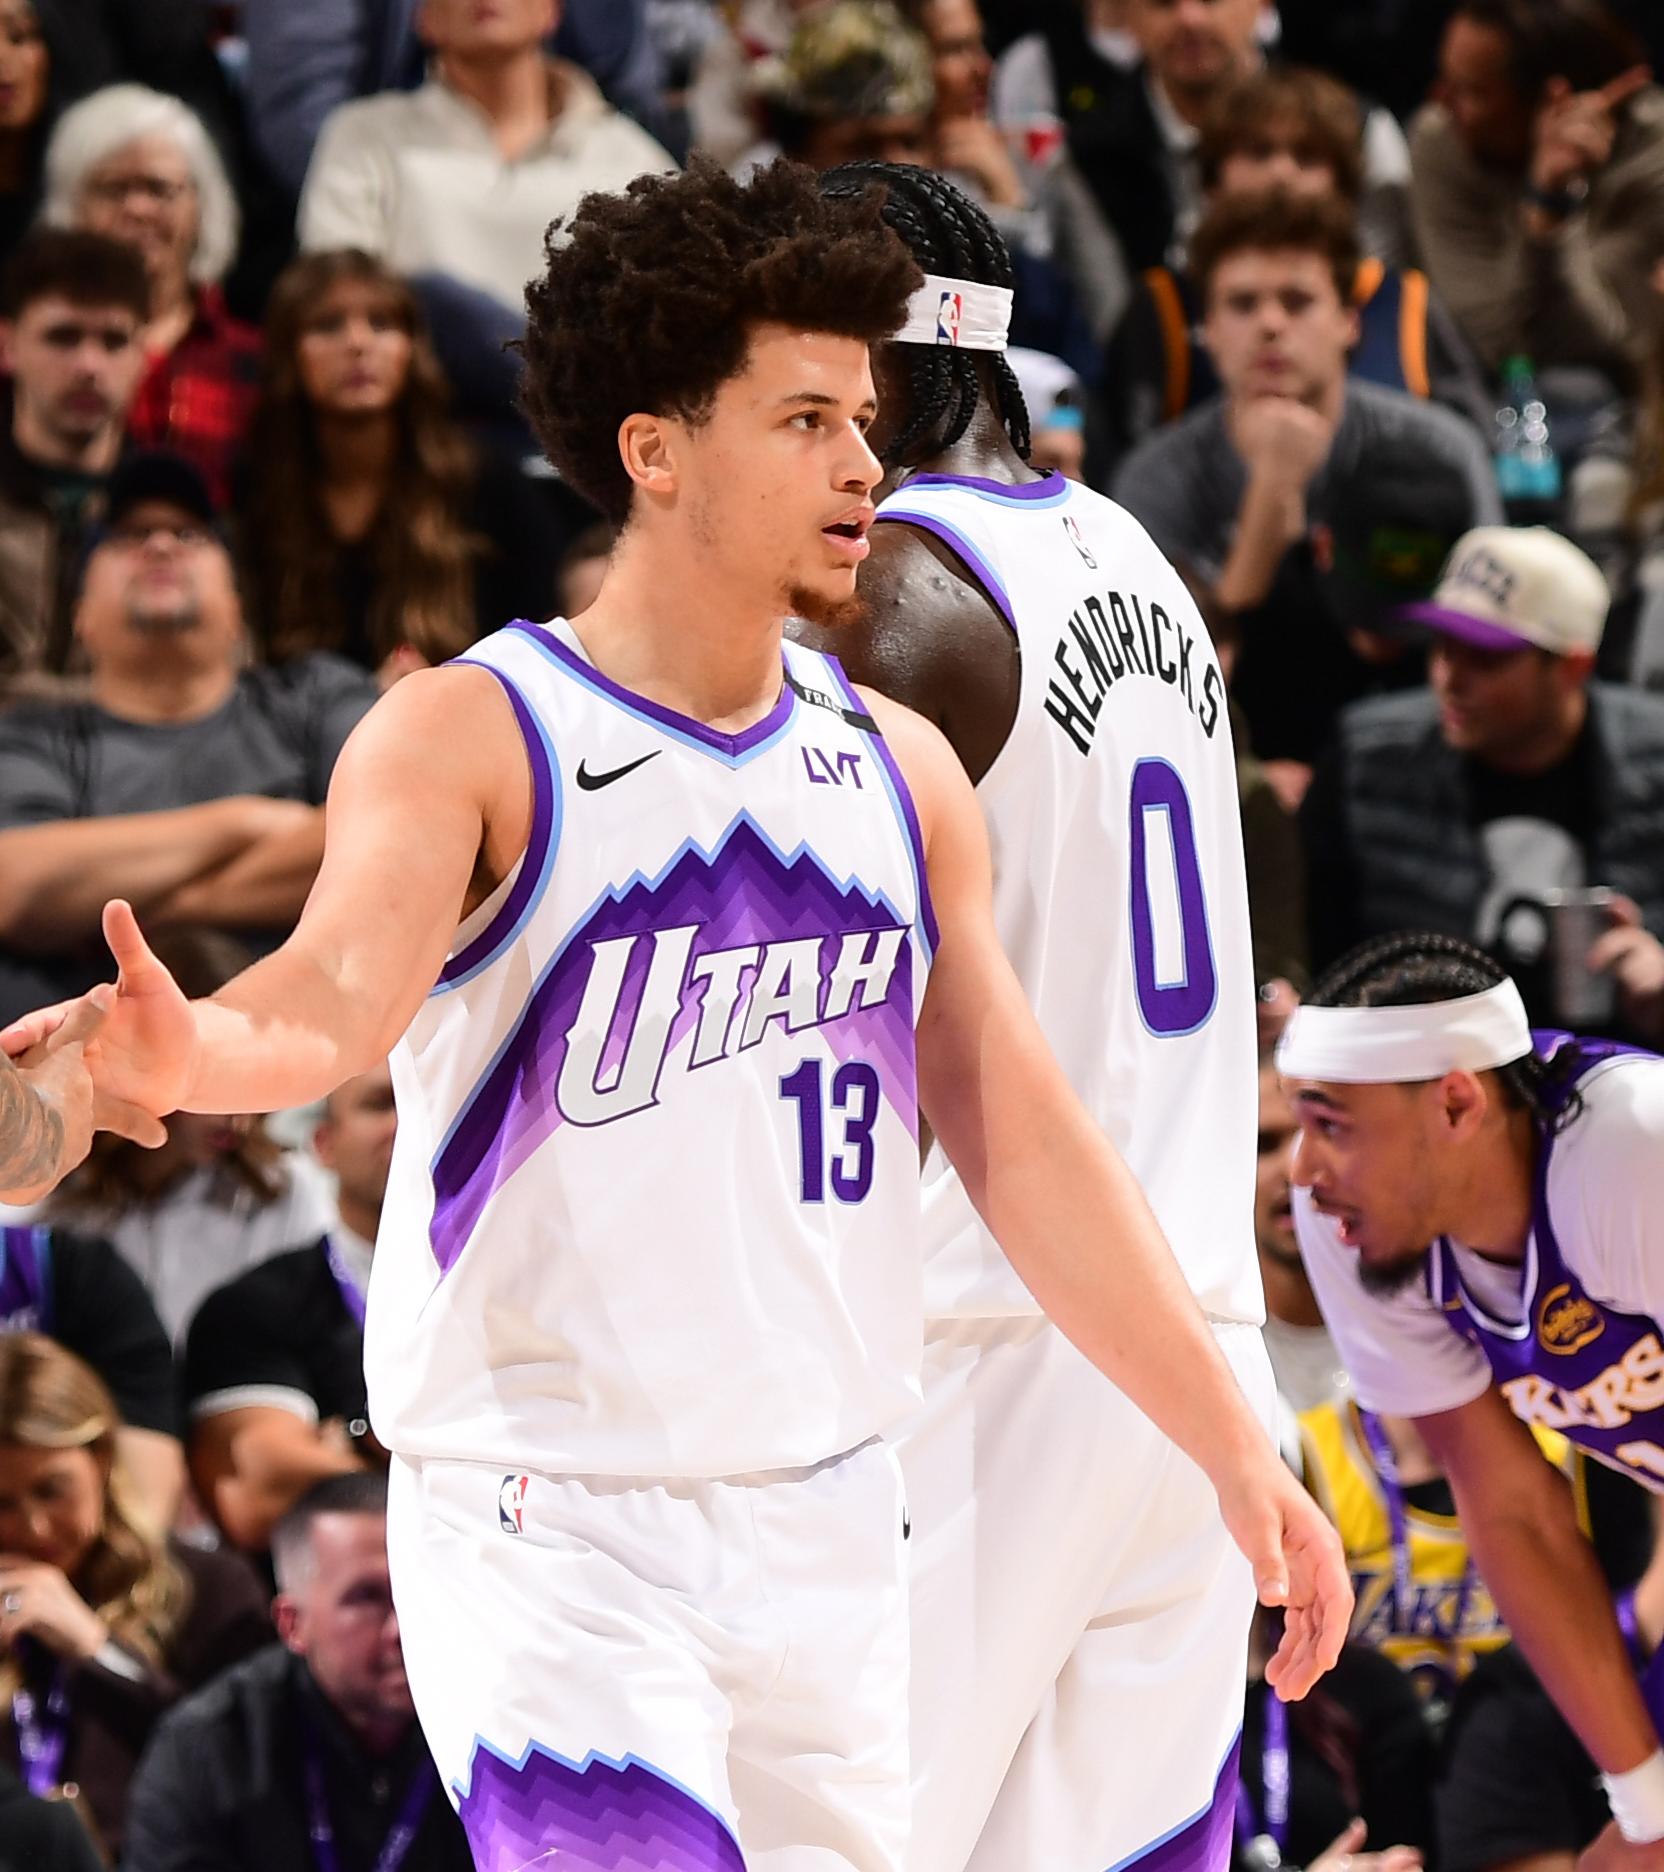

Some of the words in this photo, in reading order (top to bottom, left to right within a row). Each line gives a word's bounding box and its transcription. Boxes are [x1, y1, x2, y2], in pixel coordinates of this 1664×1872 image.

[1043, 591, 1223, 757] HENDRICKS
[1128, 756, 1219, 1038] 0
[555, 920, 913, 1128] UTAH
[778, 1057, 880, 1205] 13
